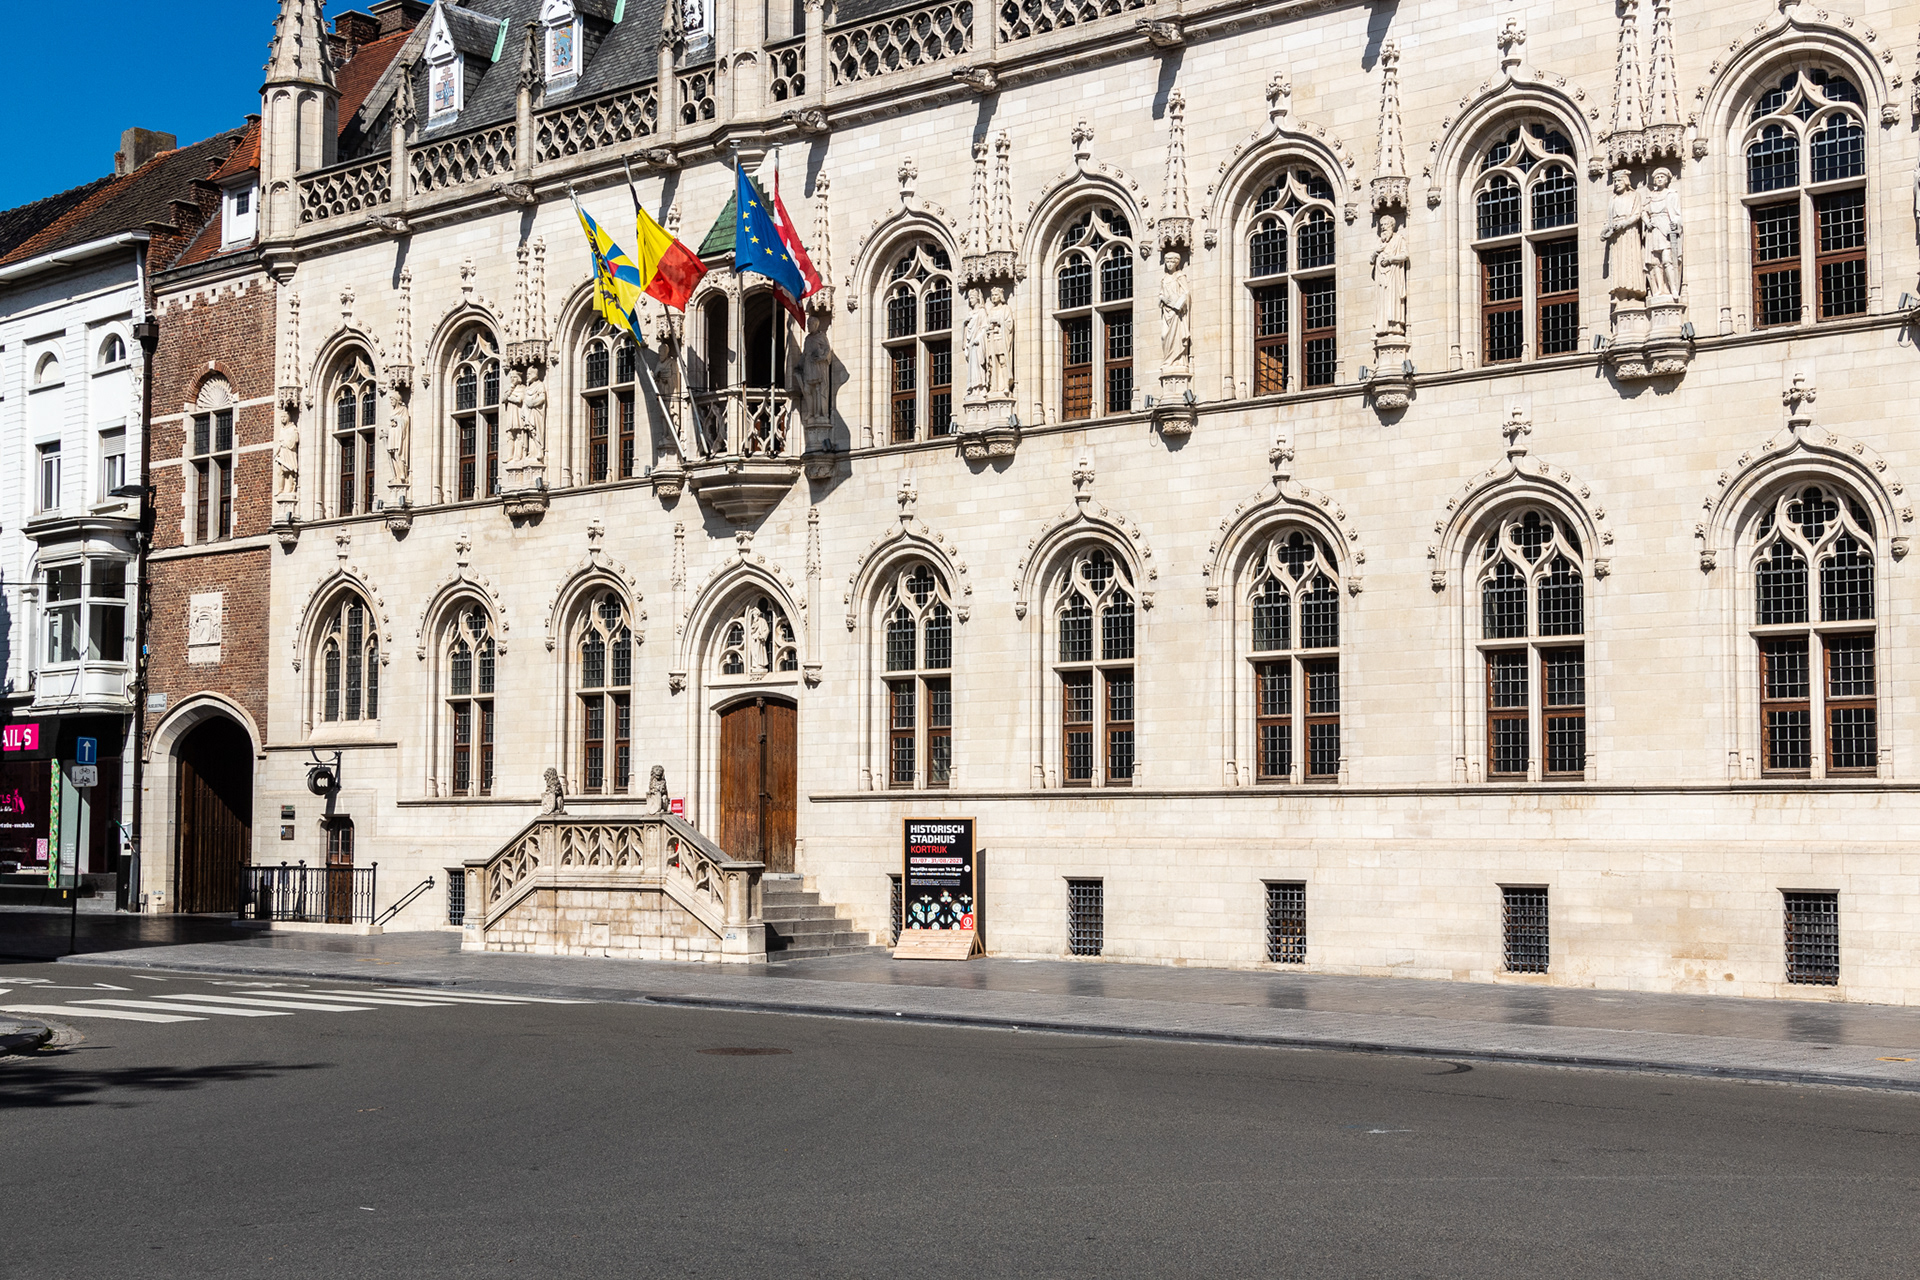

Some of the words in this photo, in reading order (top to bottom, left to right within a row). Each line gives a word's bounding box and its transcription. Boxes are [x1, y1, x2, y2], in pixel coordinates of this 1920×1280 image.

[910, 825, 965, 834] HISTORISCH
[910, 835, 956, 844] STADHUIS
[910, 846, 948, 854] KORTRIJK
